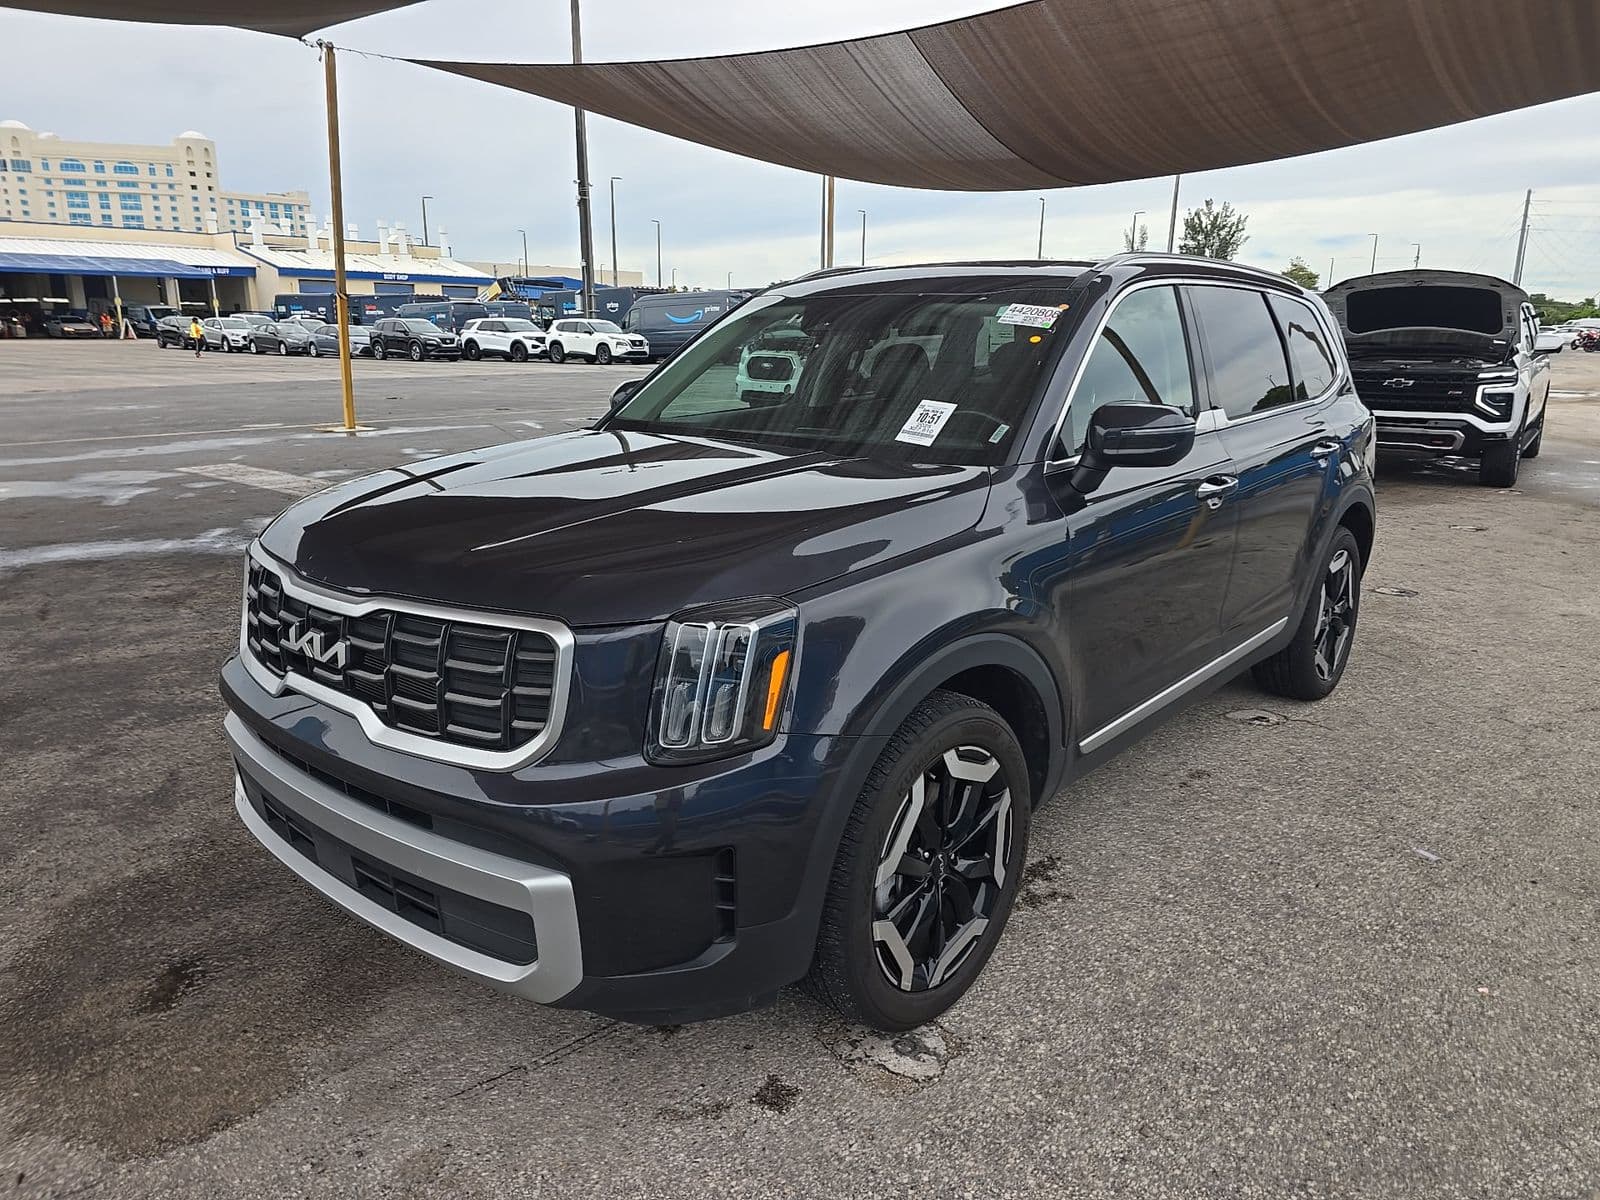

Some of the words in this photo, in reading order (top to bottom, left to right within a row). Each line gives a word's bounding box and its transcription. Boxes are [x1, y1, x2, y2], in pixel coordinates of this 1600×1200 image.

[704, 304, 720, 314] prime
[916, 412, 942, 425] 10:51
[279, 622, 348, 669] KIA
